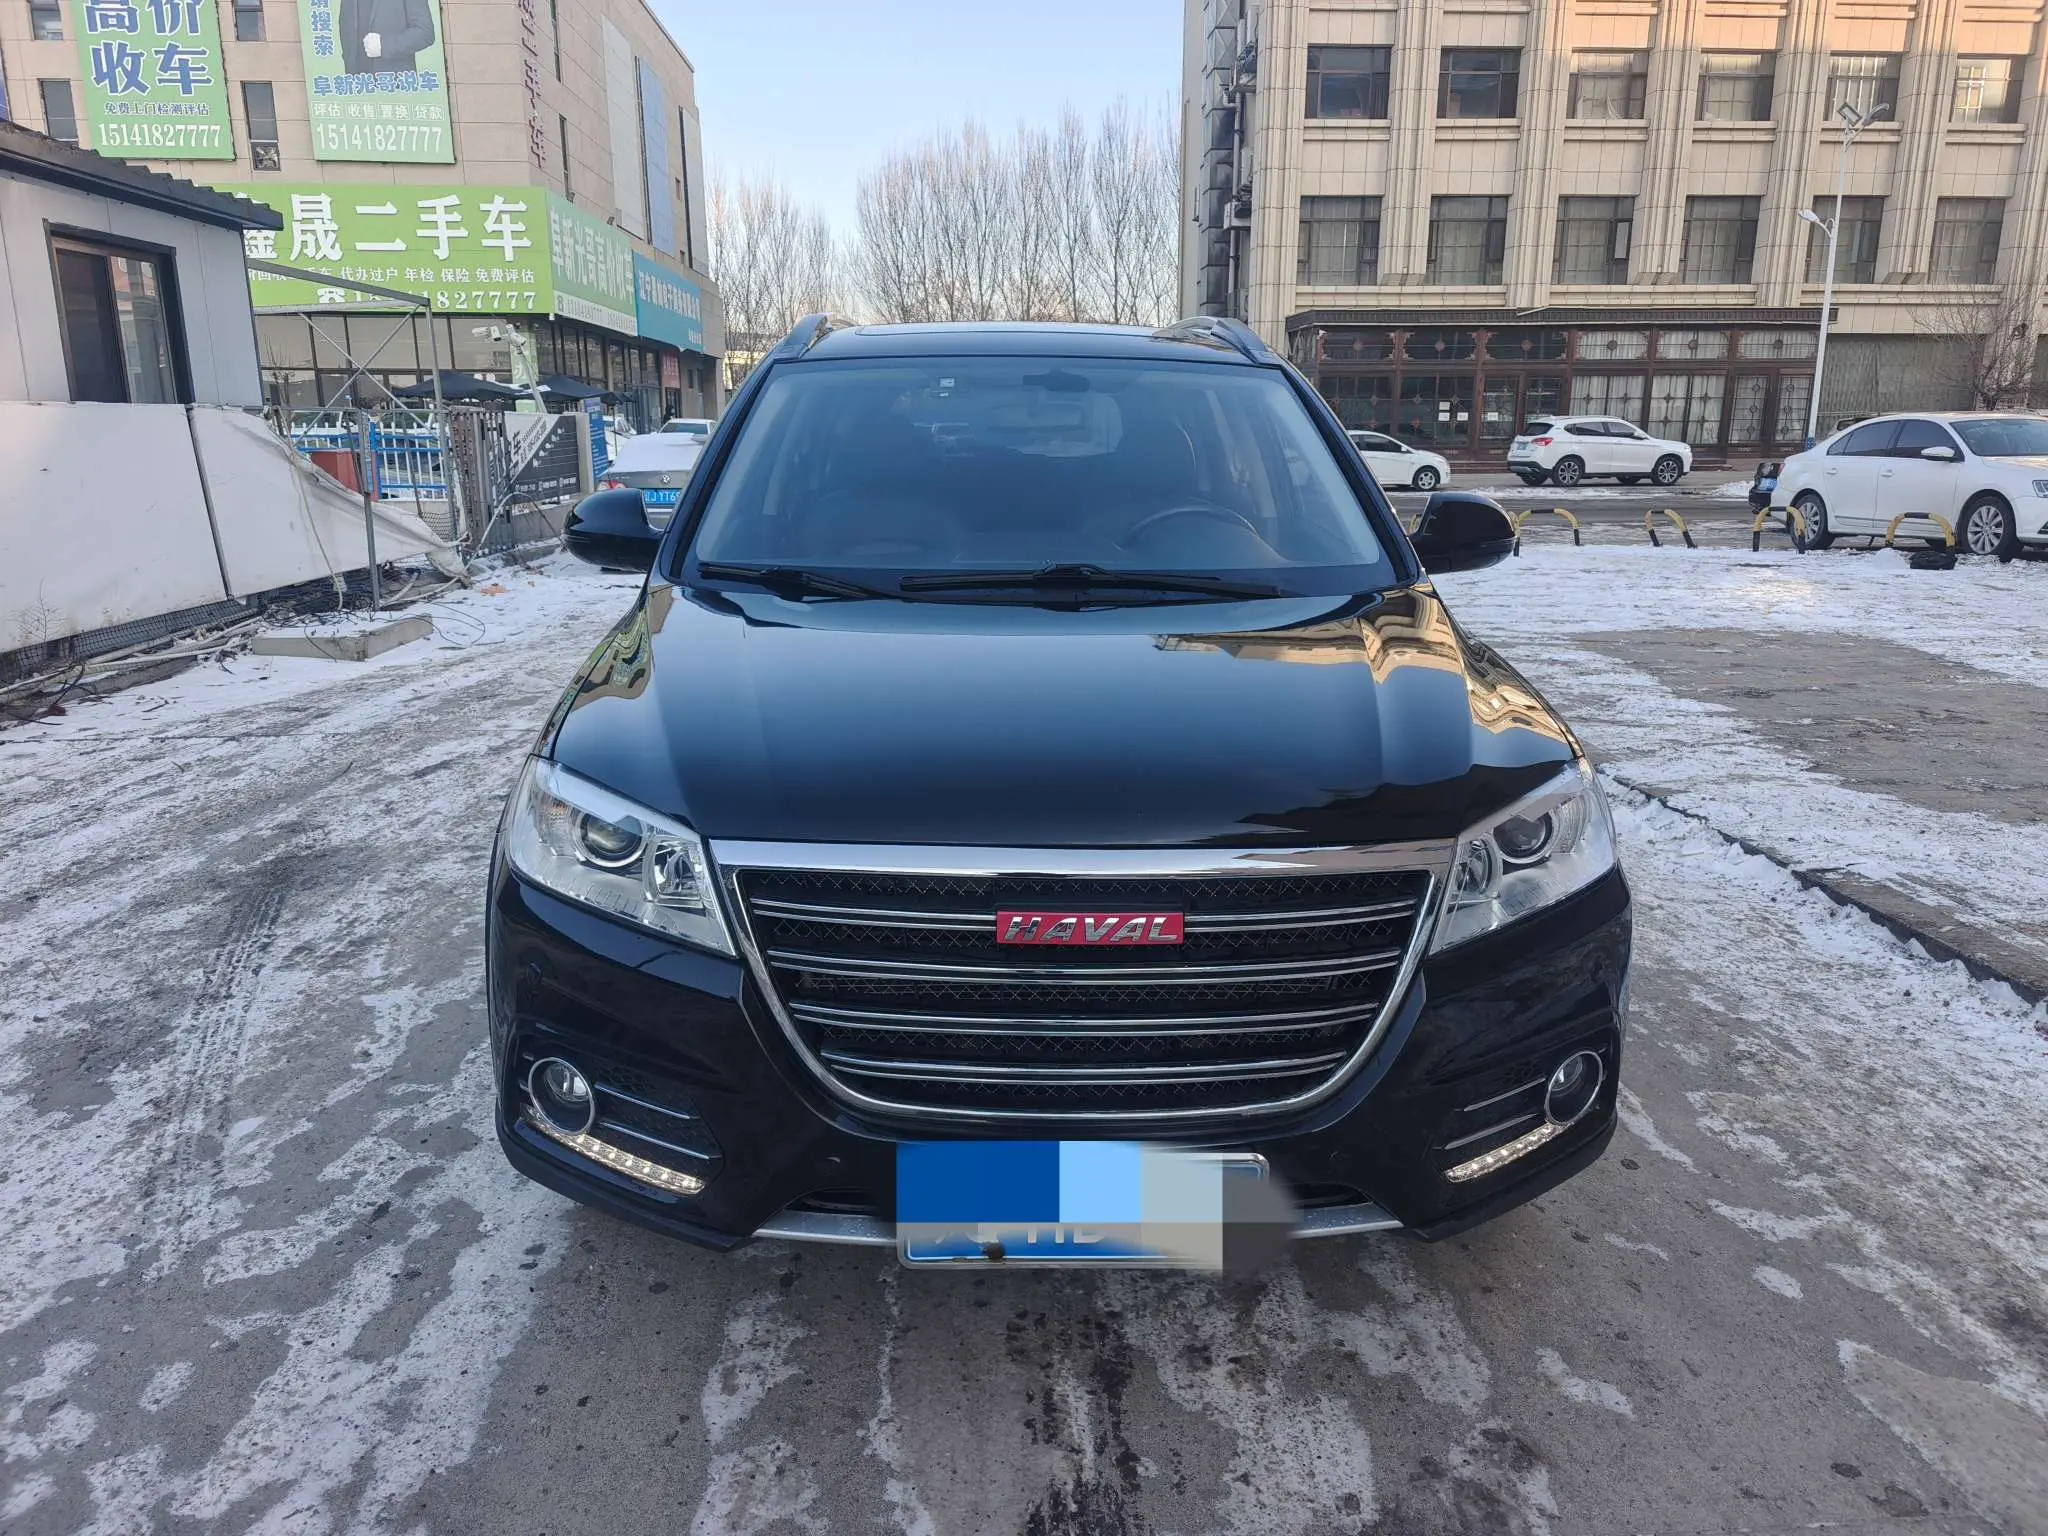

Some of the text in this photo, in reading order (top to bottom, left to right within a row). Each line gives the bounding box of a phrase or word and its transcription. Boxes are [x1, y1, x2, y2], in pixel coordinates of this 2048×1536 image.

[84, 0, 205, 35] 高价
[90, 40, 214, 96] 收车
[313, 70, 440, 96] 阜新光哥说车
[105, 102, 209, 117] 免费上门检测评估
[313, 103, 342, 117] 评估
[380, 105, 409, 119] 置换
[414, 105, 443, 120] 贷款
[98, 123, 221, 148] 15141827777
[316, 123, 443, 152] 15141827777
[550, 204, 634, 304] 阜新光哥高价收车
[340, 265, 398, 281] 代办过户
[404, 267, 434, 283] 年检
[440, 268, 471, 283] 保险
[475, 268, 534, 284] 免费评估
[1003, 916, 1178, 942] HAVAL
